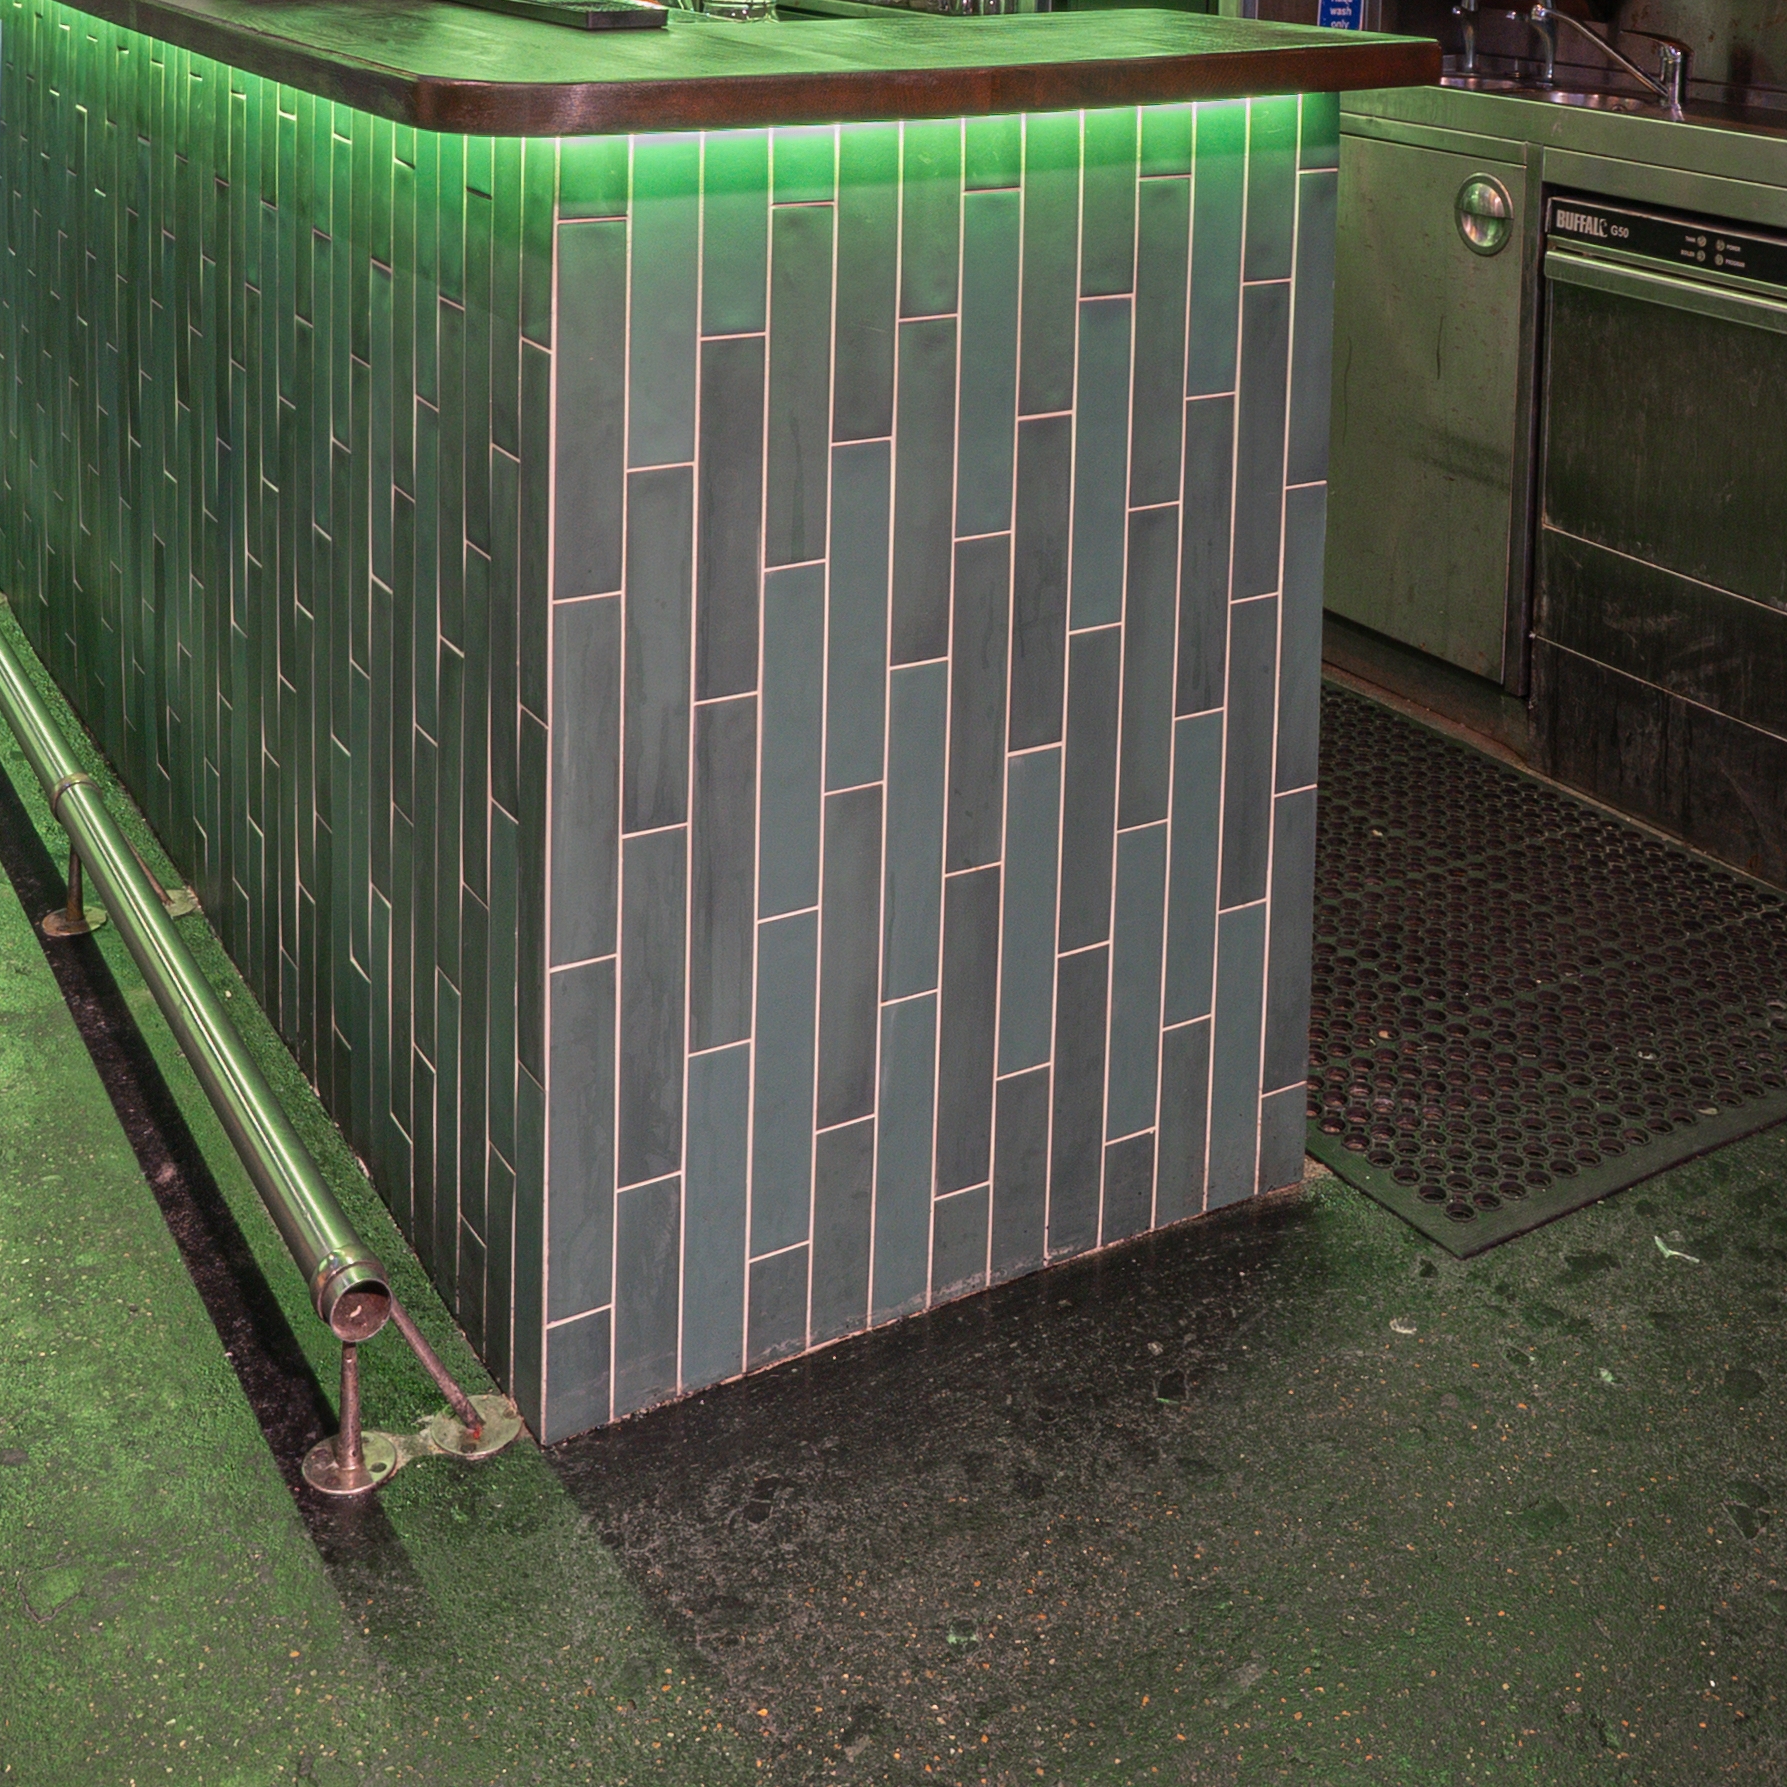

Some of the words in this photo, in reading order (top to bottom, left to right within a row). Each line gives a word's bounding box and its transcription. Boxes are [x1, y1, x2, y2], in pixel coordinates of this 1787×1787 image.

[1329, 6, 1353, 16] wash
[1330, 19, 1350, 30] only
[1610, 224, 1630, 239] G50
